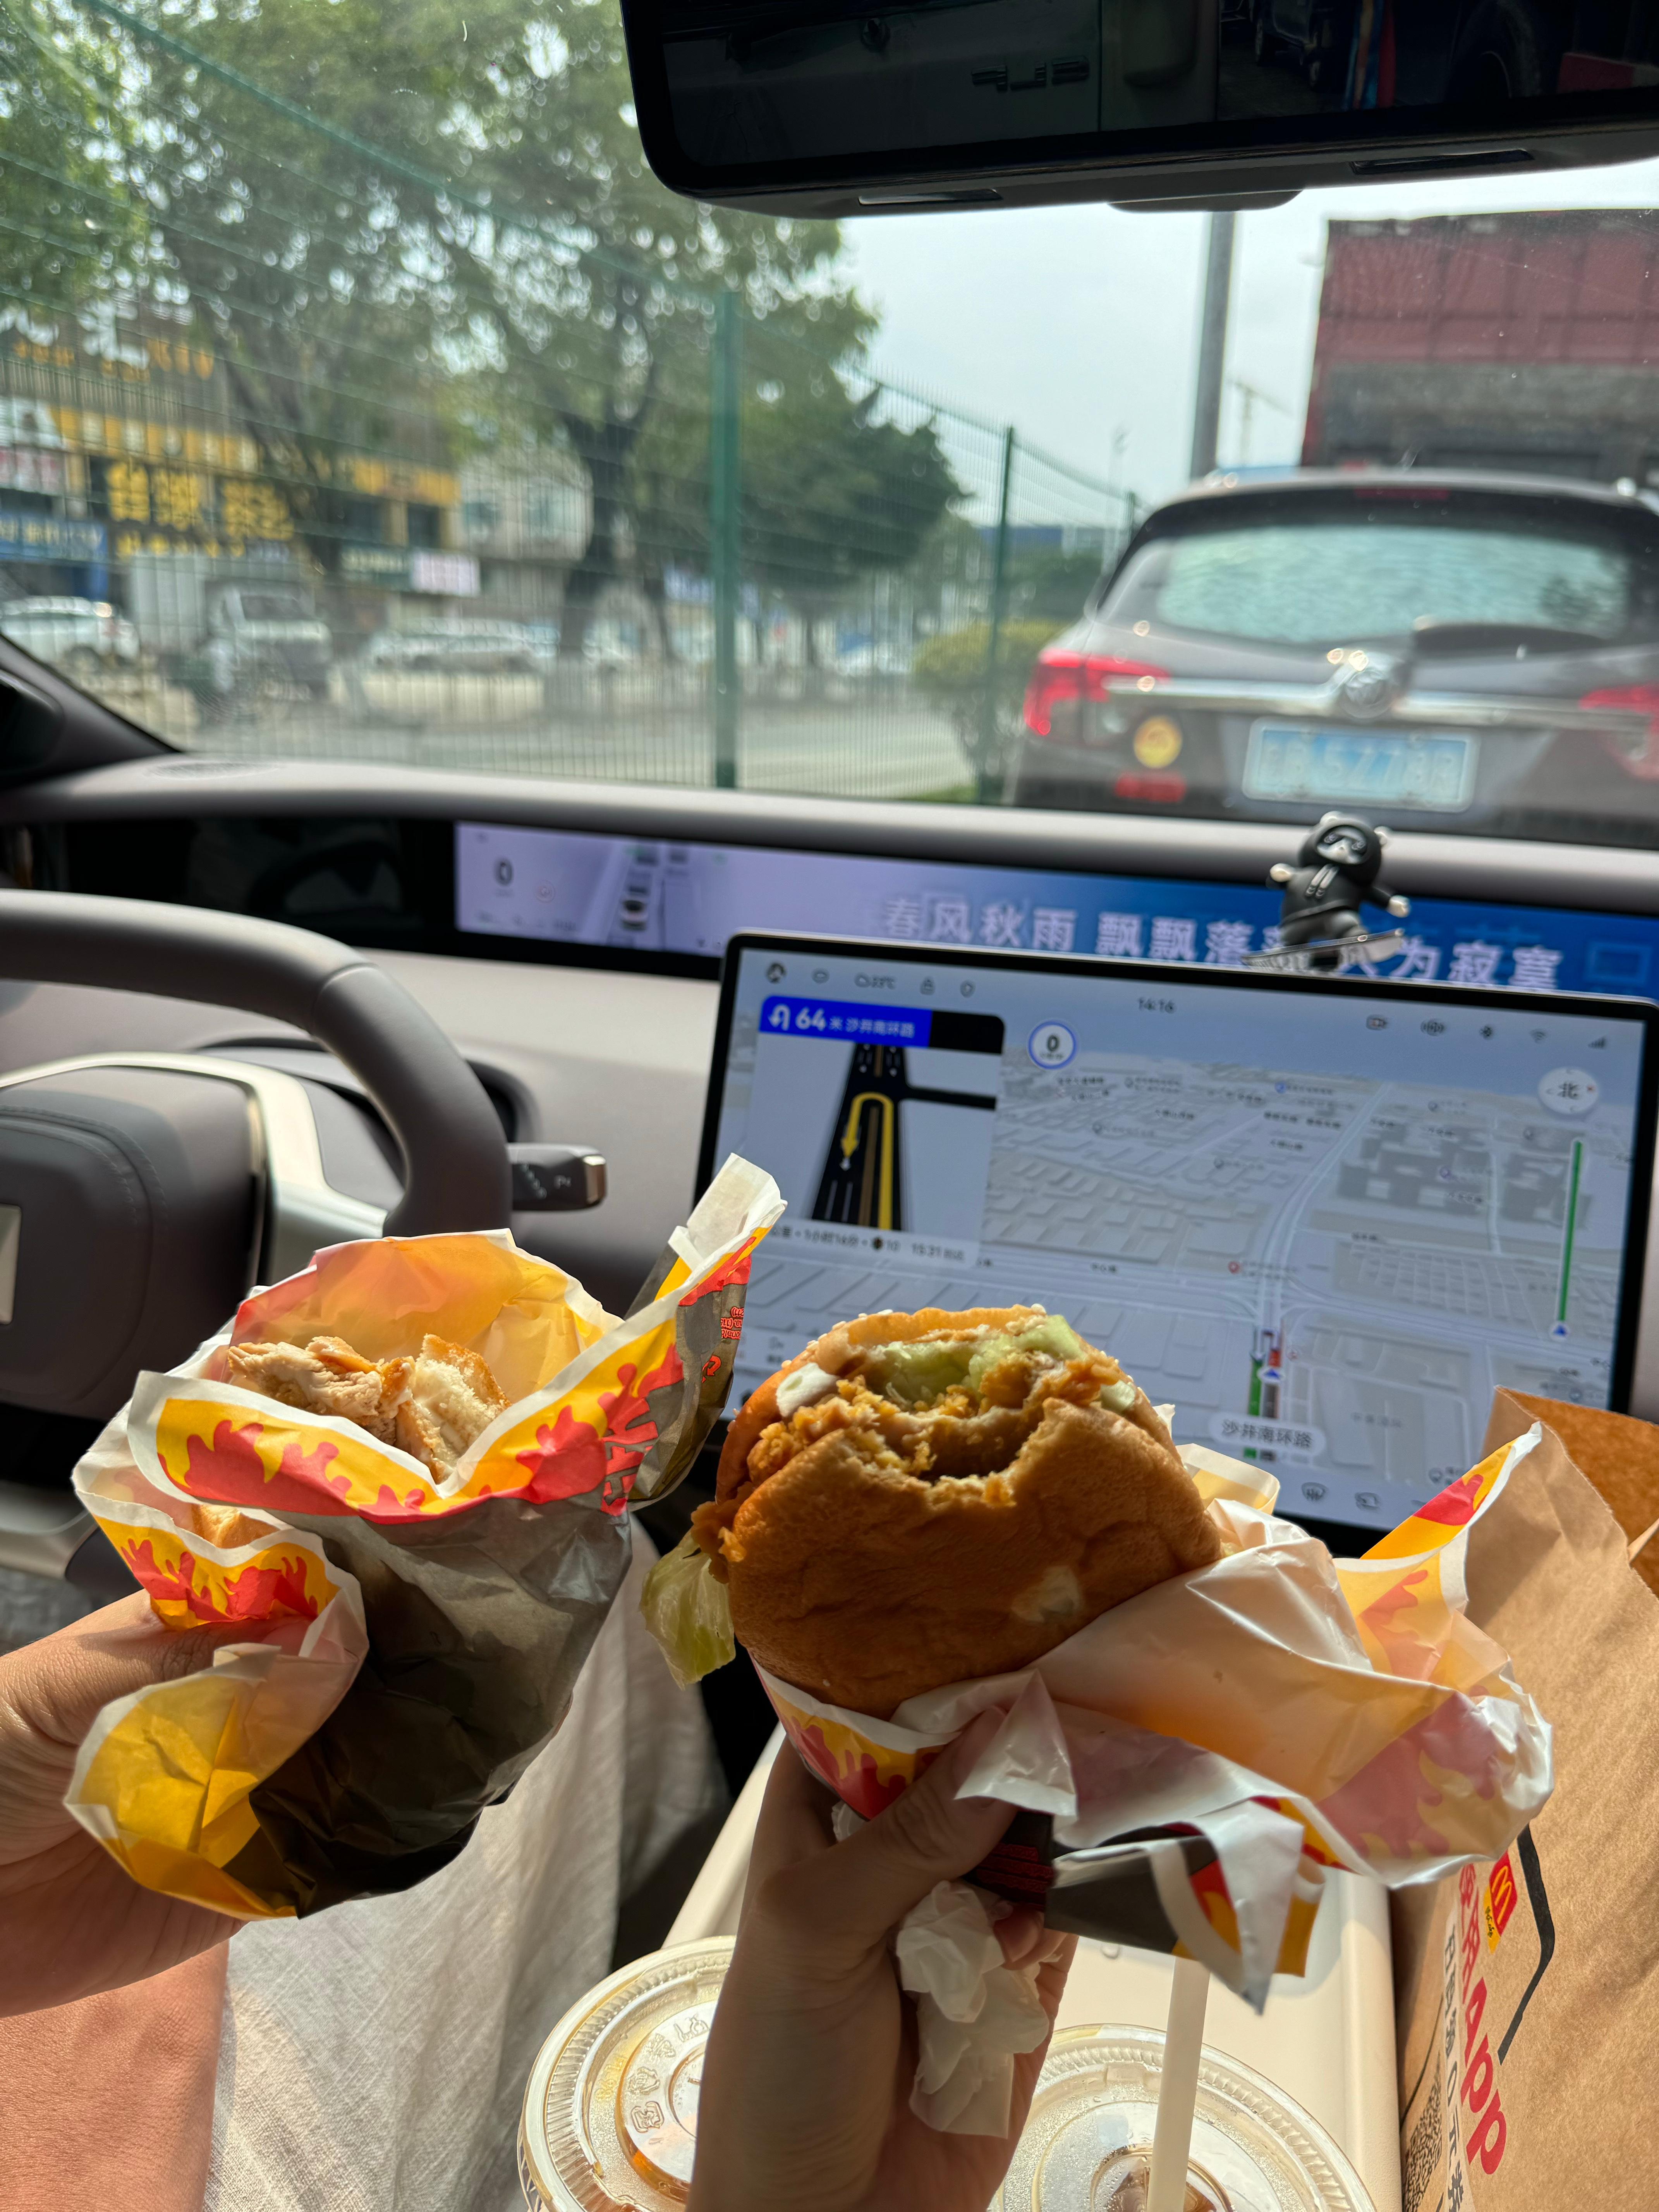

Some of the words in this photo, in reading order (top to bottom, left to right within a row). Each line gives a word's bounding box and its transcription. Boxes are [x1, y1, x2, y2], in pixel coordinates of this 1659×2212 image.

[883, 896, 1076, 951] 春风秋雨
[1097, 912, 1562, 990] 飘飘落为寂寞
[1138, 998, 1176, 1013] 14:16
[795, 1006, 825, 1031] 64
[830, 1017, 843, 1032] 米
[1047, 1034, 1059, 1052] 0
[1556, 1080, 1579, 1099] 北
[1222, 1419, 1313, 1448] 沙井南环路
